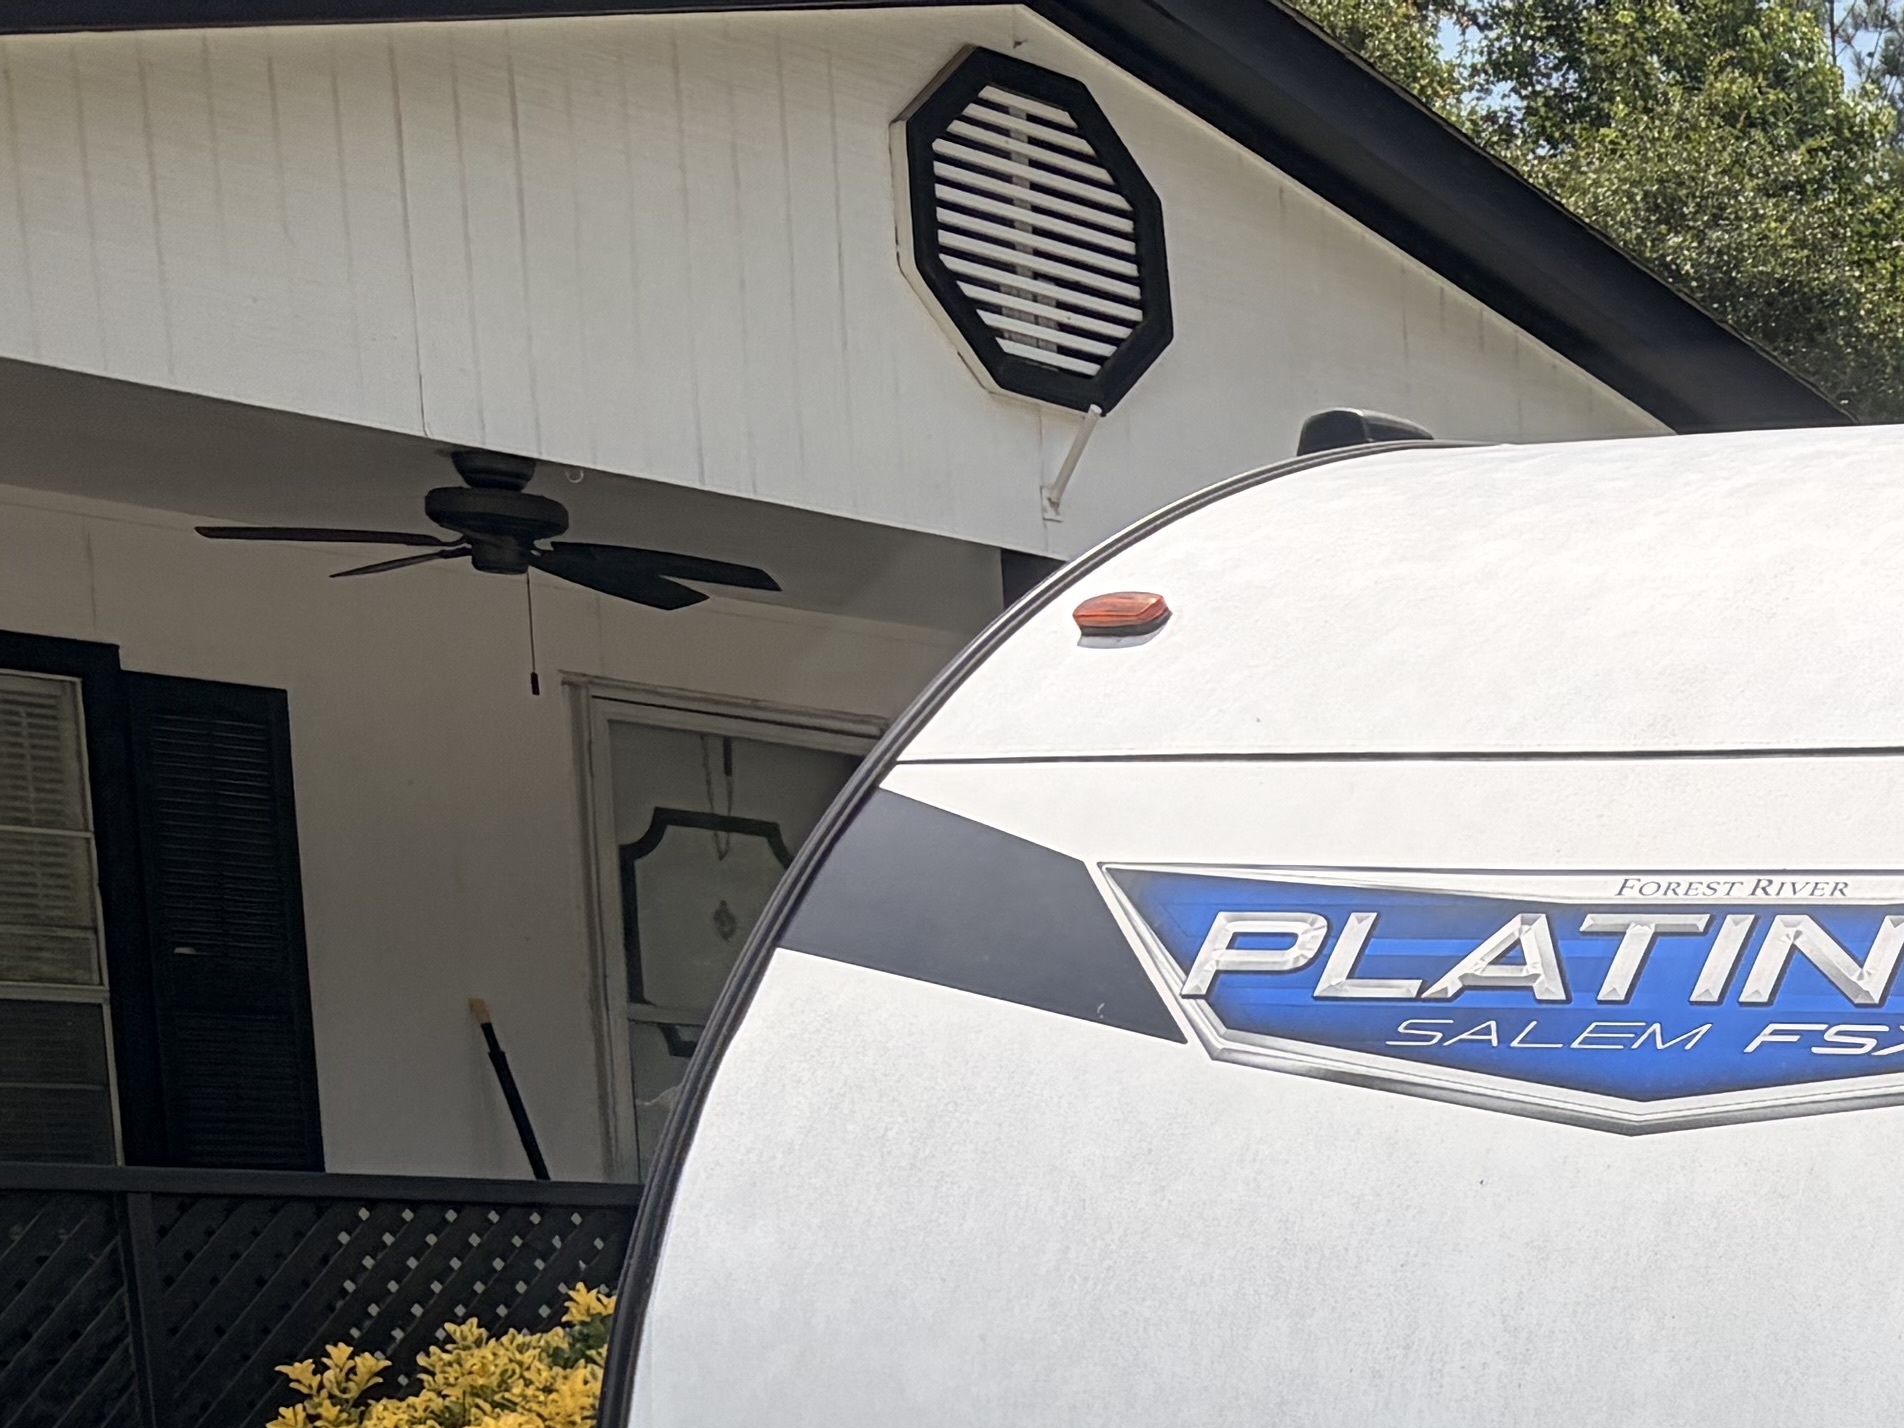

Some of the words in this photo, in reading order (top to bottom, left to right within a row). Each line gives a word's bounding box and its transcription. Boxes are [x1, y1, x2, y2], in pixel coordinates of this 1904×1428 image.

[1615, 878, 1743, 897] FOREST
[1748, 878, 1849, 897] RIVER
[1385, 1018, 1713, 1050] SALEM
